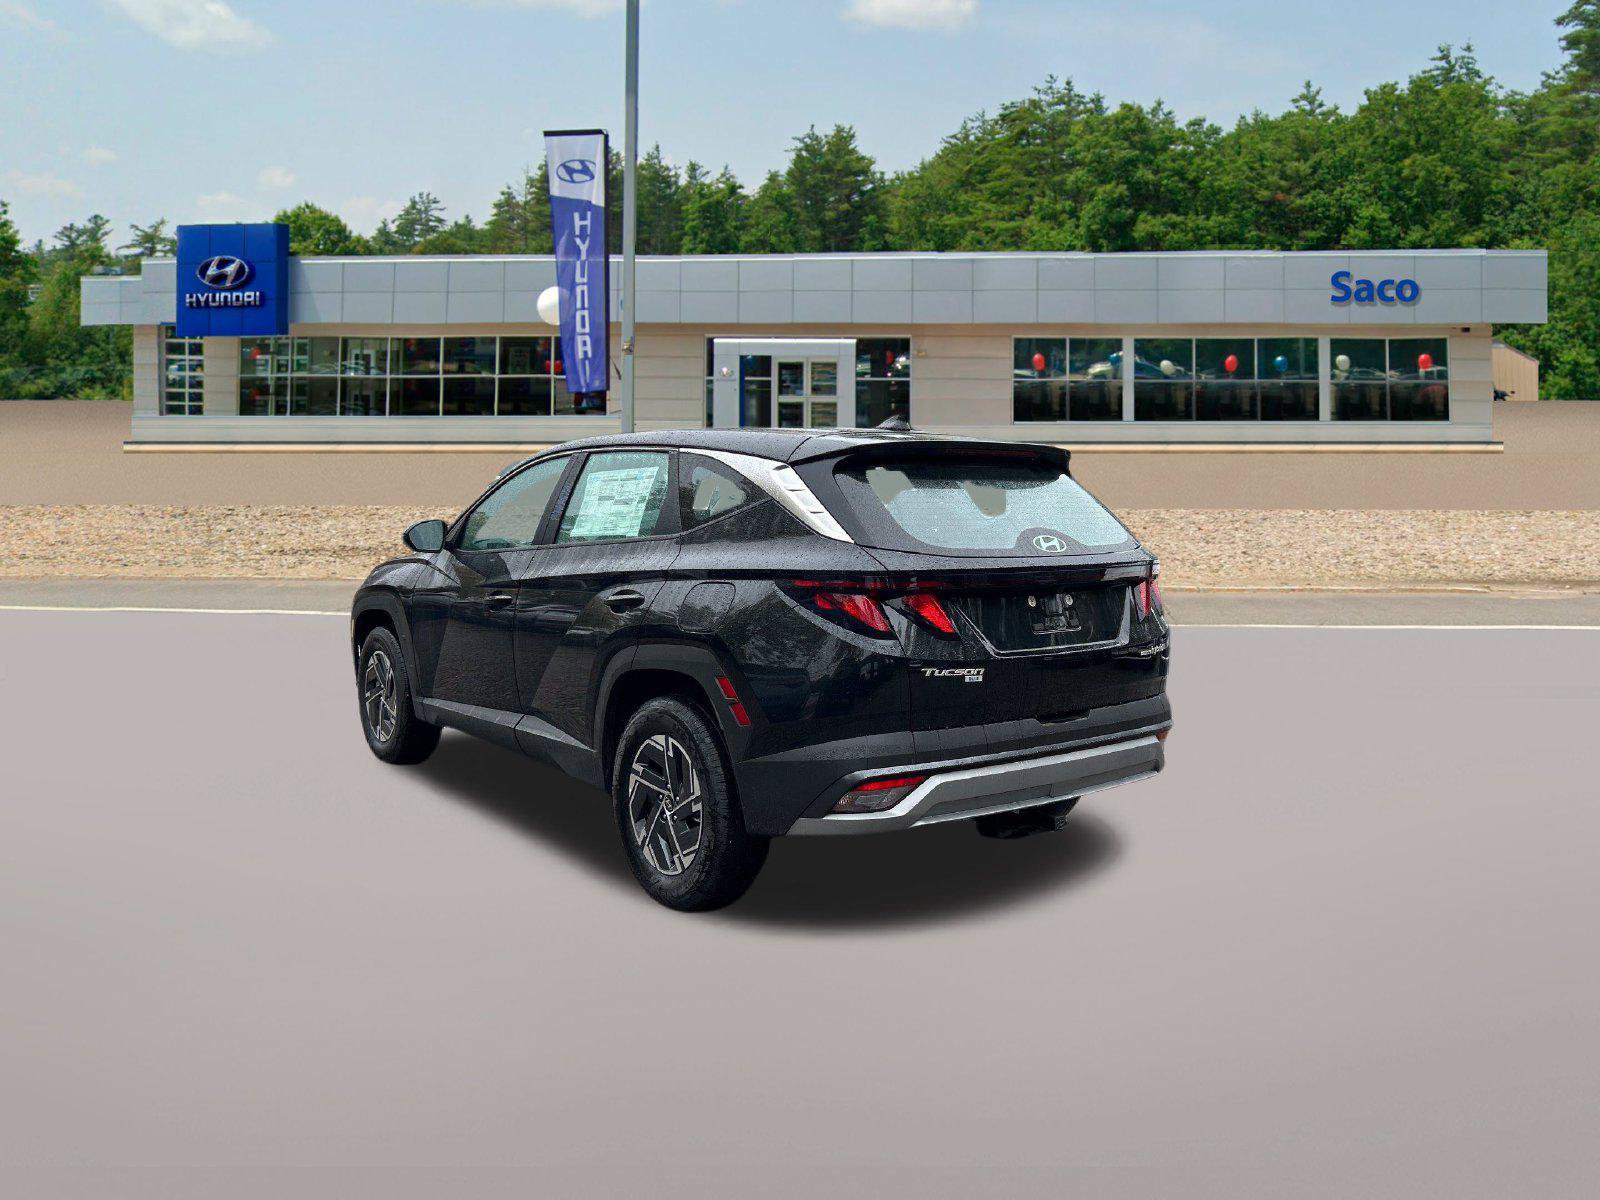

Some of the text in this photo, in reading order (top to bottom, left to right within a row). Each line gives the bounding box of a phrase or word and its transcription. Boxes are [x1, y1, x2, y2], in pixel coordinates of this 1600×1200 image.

[185, 291, 260, 307] HYUNDAI
[573, 211, 592, 383] HYUNDAI
[1330, 270, 1420, 303] Saco
